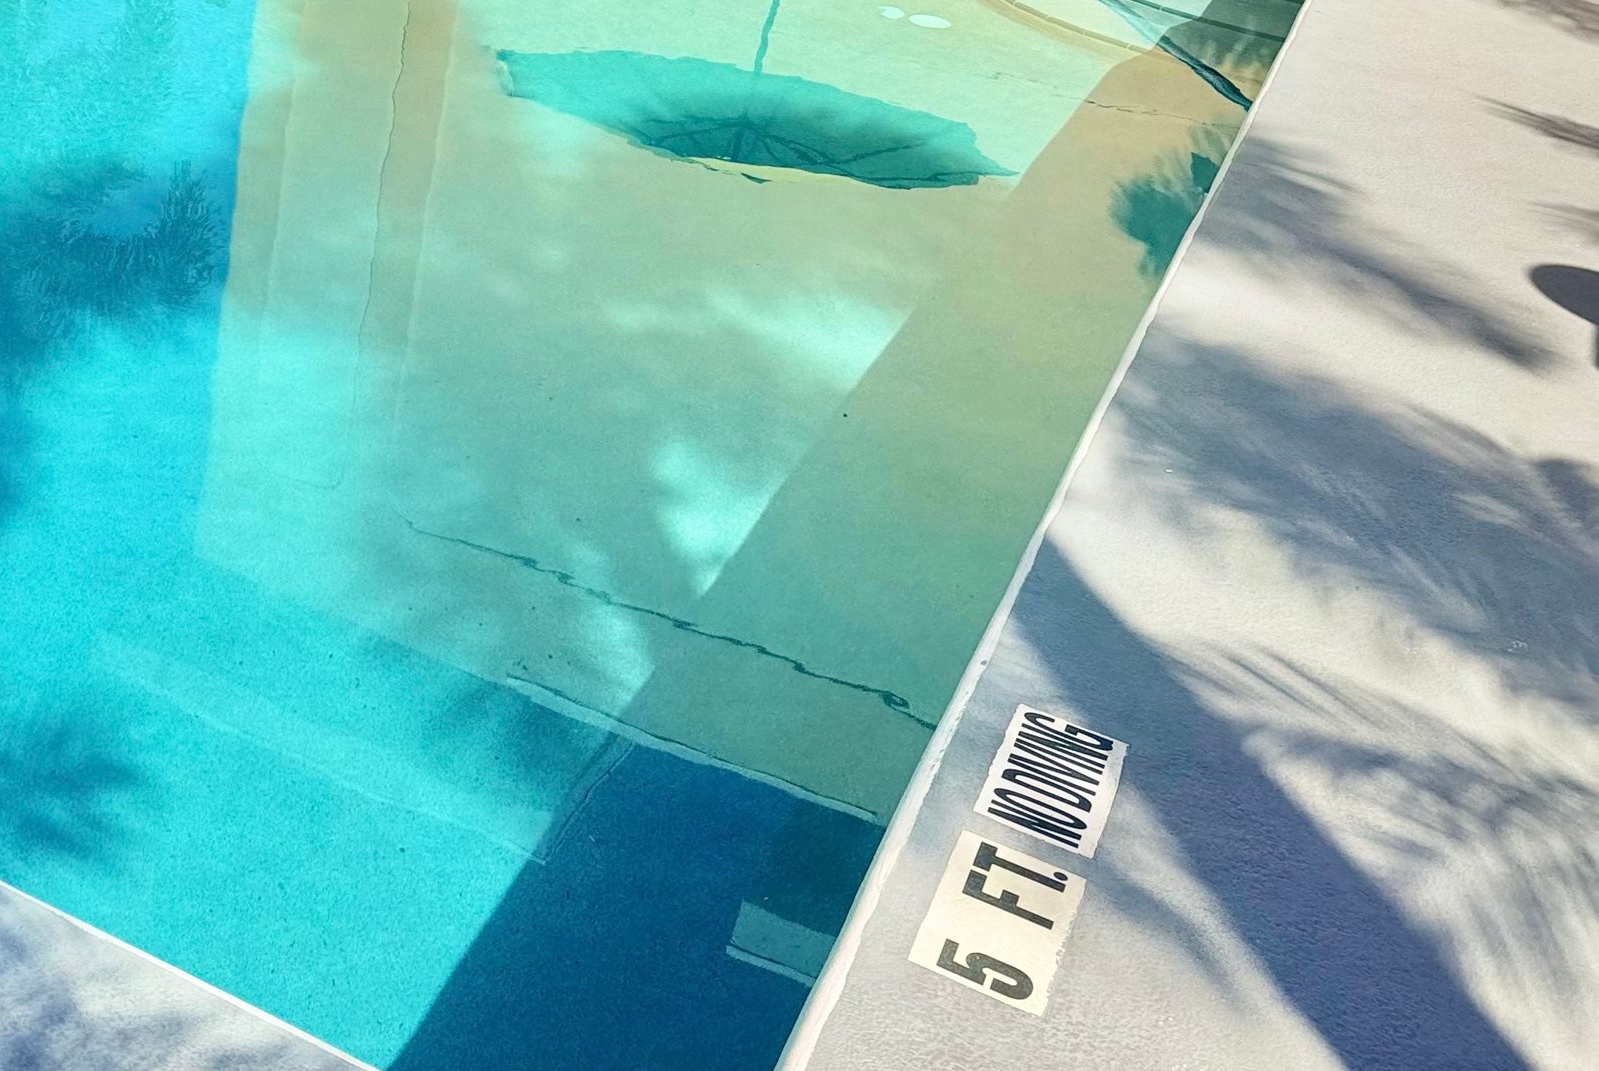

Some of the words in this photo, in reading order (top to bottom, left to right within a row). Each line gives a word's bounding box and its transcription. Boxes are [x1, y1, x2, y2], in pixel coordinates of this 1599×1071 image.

[1001, 711, 1114, 813] DIVING
[962, 841, 1069, 930] FT.
[936, 938, 1034, 1000] 5
